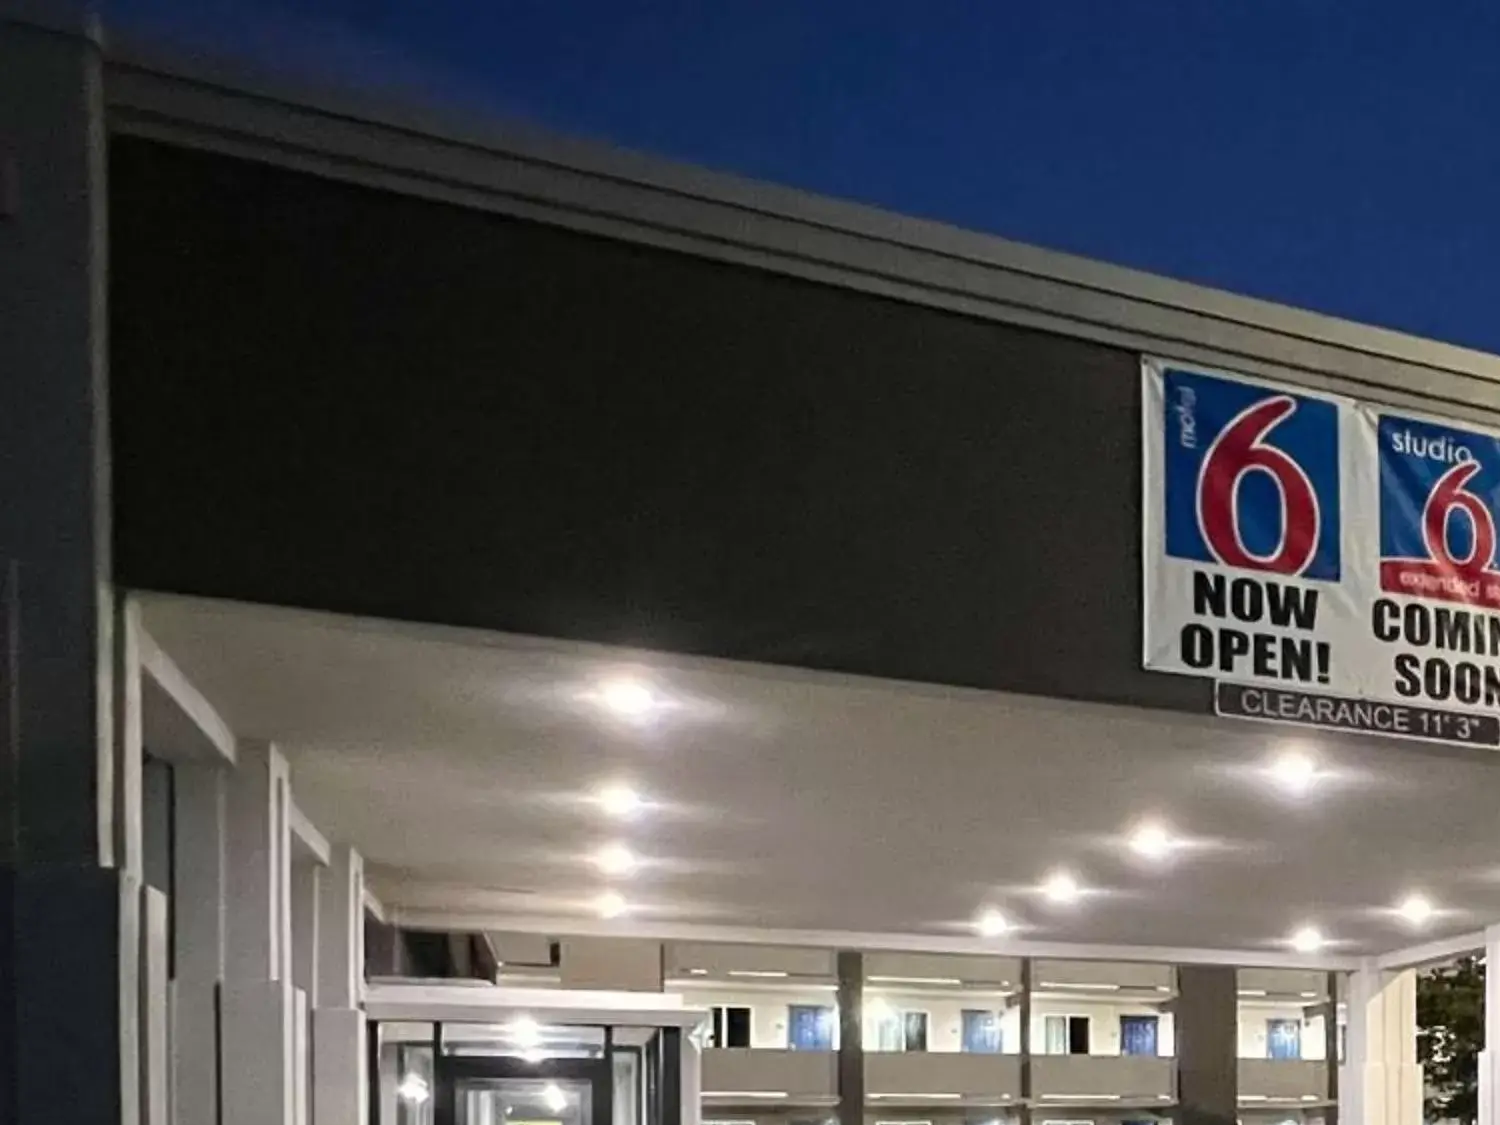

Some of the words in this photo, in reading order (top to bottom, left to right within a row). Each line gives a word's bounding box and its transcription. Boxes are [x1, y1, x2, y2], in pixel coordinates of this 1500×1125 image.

[1391, 429, 1473, 464] studio
[1195, 395, 1321, 578] 6
[1421, 460, 1497, 573] 6
[1193, 572, 1319, 631] NOW
[1398, 570, 1480, 600] extended
[1180, 624, 1330, 682] OPEN!
[1241, 690, 1409, 733] CLEARANCE
